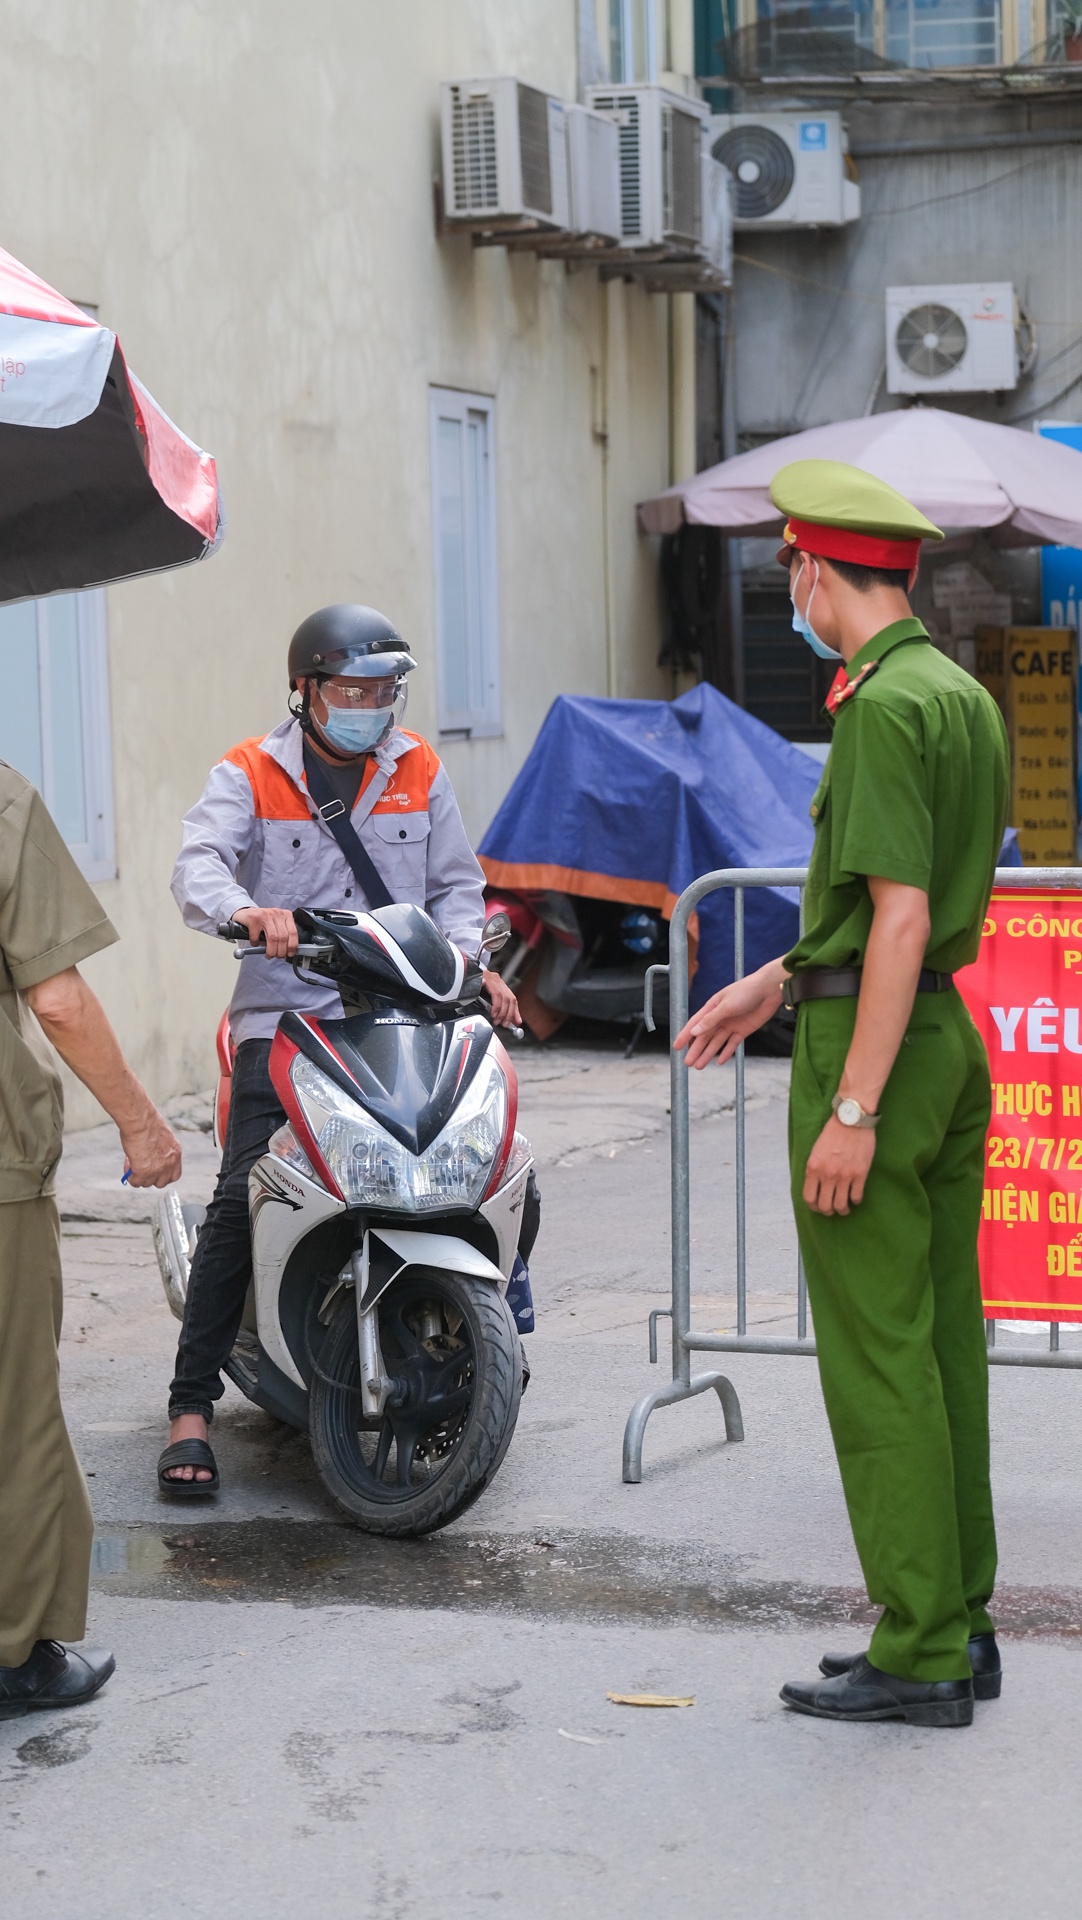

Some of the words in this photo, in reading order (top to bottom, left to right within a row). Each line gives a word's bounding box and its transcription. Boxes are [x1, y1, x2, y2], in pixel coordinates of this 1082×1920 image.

[1, 357, 26, 379] lập
[1011, 651, 1072, 676] CAFE
[374, 1017, 421, 1026] HONDA
[989, 997, 1082, 1055] YÊU
[991, 1080, 1053, 1123] HỰC
[1062, 1085, 1082, 1117] H
[988, 1136, 1082, 1171] 23/7/2
[273, 1168, 306, 1198] HONDA
[1048, 1188, 1082, 1225] GI
